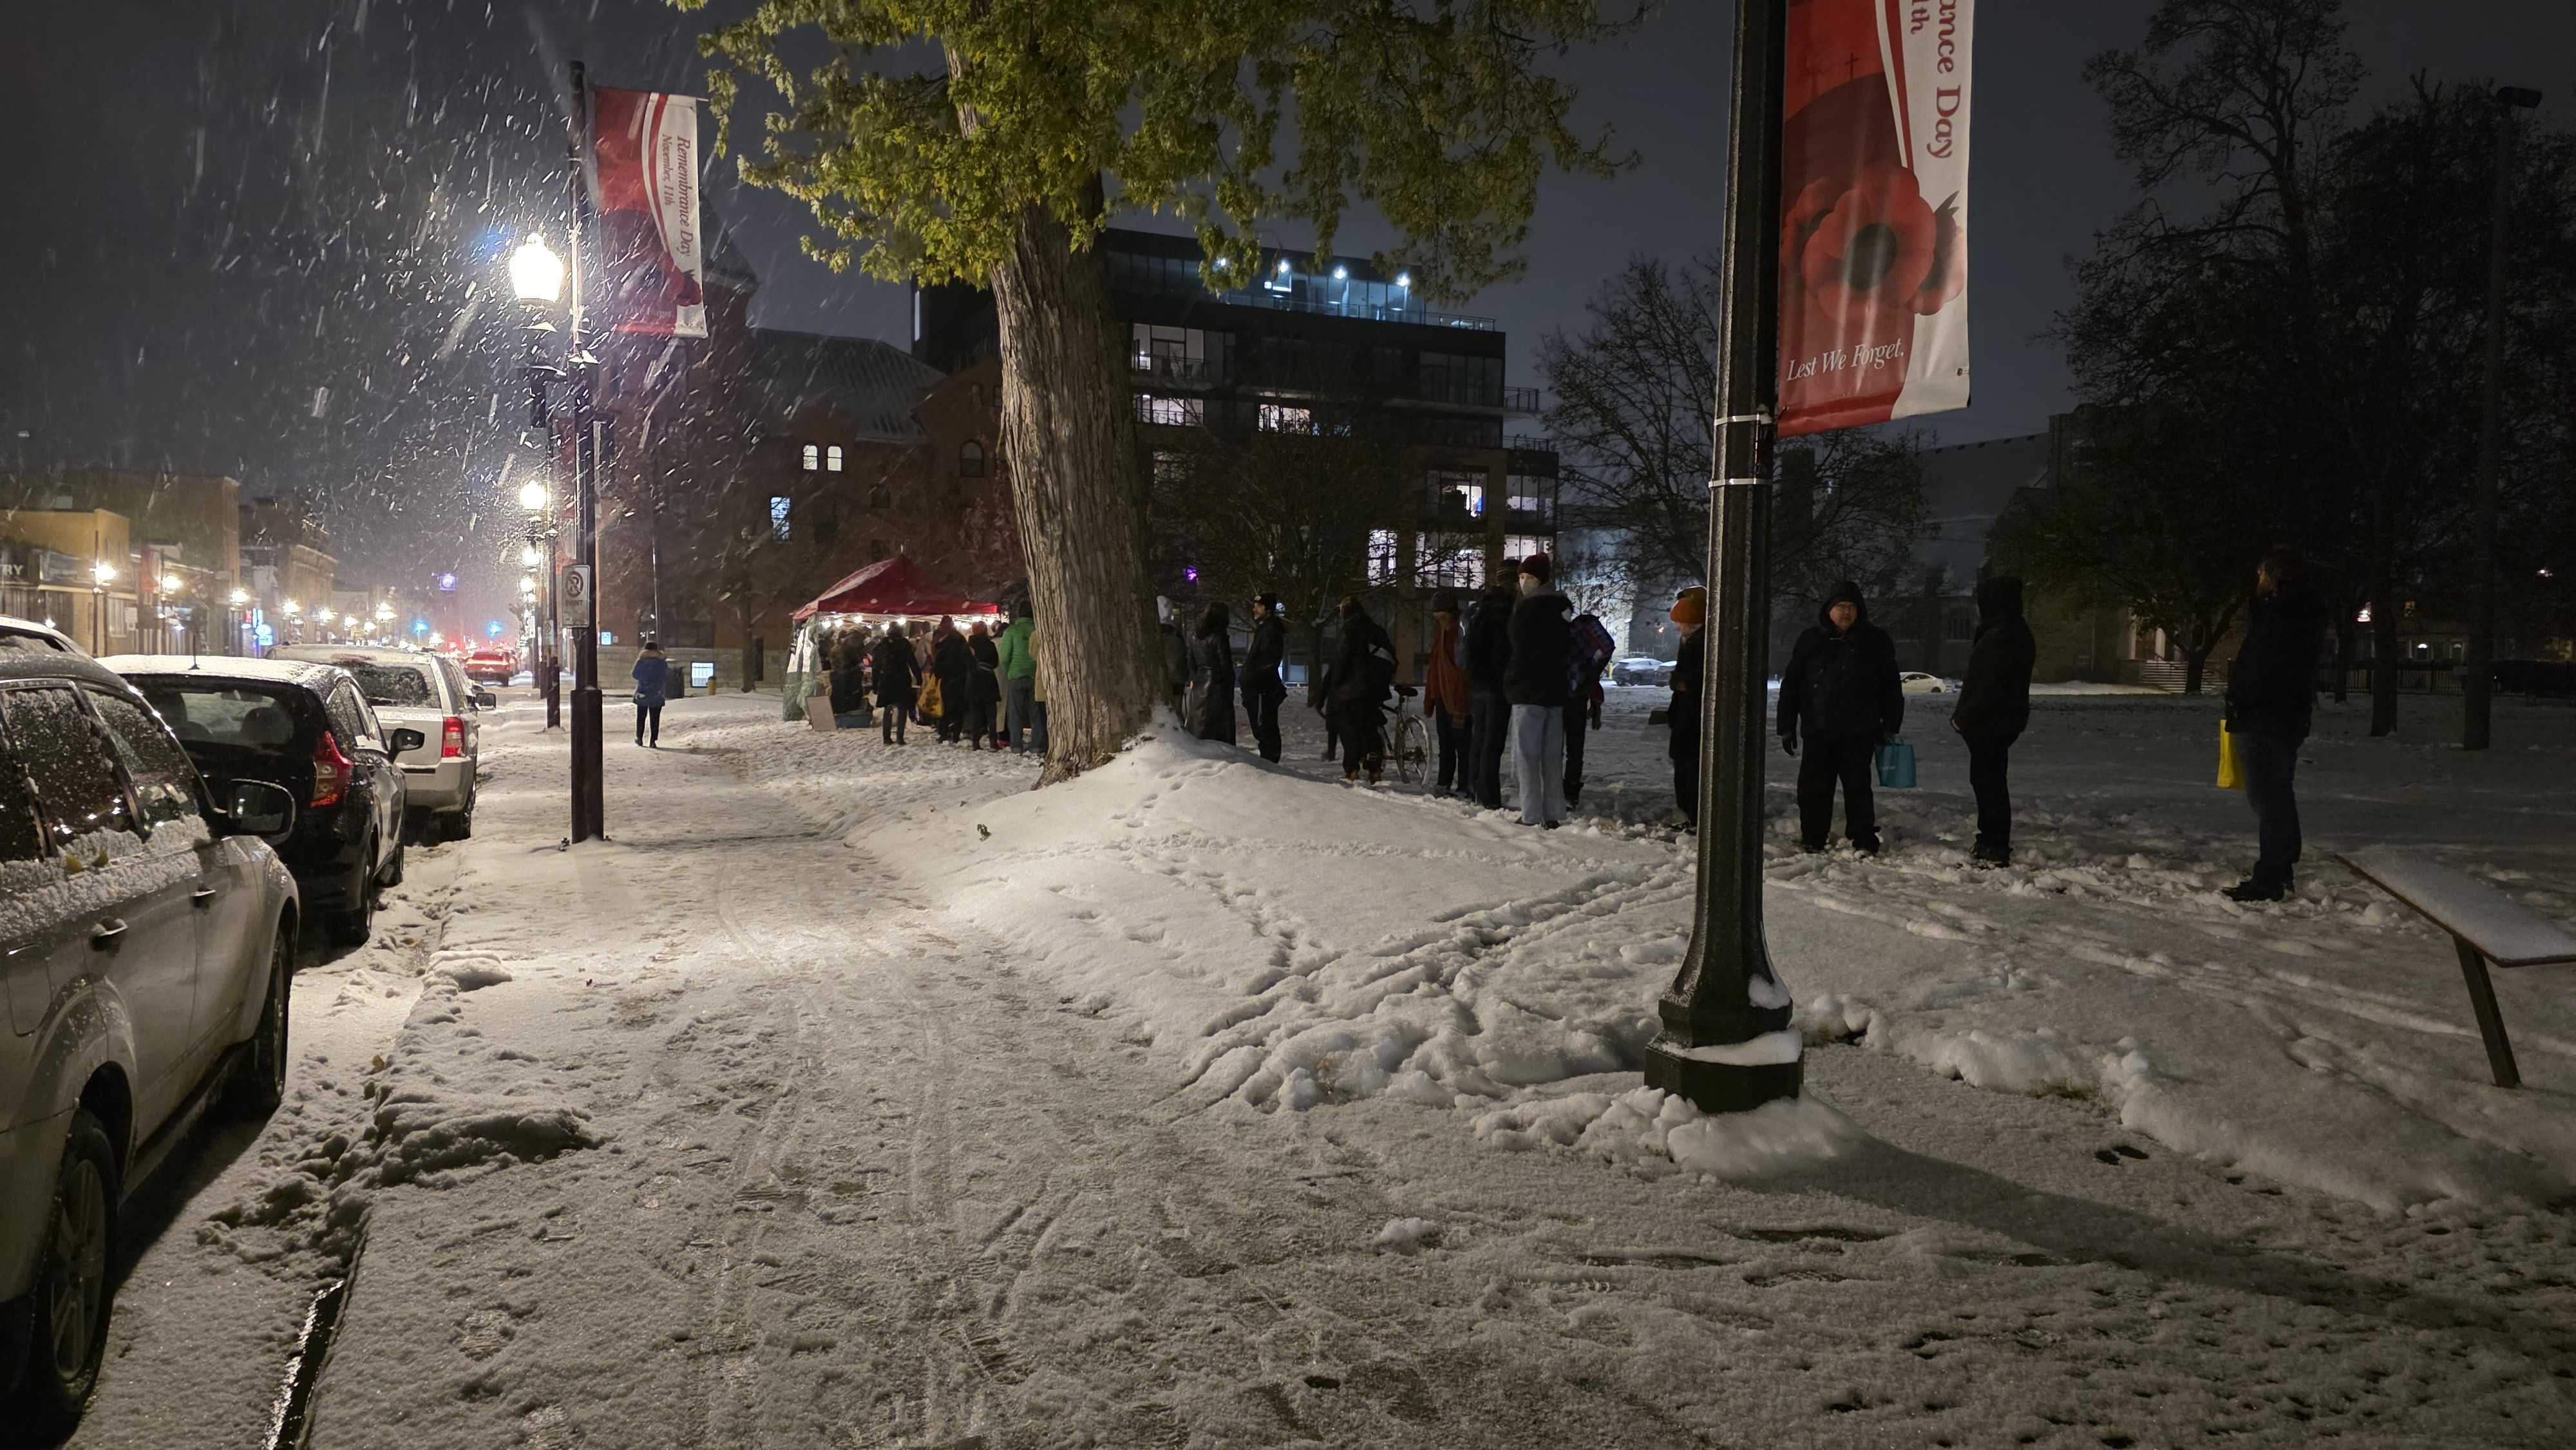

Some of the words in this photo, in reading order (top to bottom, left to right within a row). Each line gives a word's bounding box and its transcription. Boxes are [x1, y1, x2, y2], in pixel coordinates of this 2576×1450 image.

[1927, 84, 1961, 158] Day
[662, 134, 674, 182] November,
[664, 185, 675, 205] 11th
[677, 136, 692, 227] Remembrance
[677, 229, 694, 257] Day
[1786, 357, 1817, 381] Lest
[1822, 348, 1847, 373] We
[1850, 338, 1904, 370] Forget.
